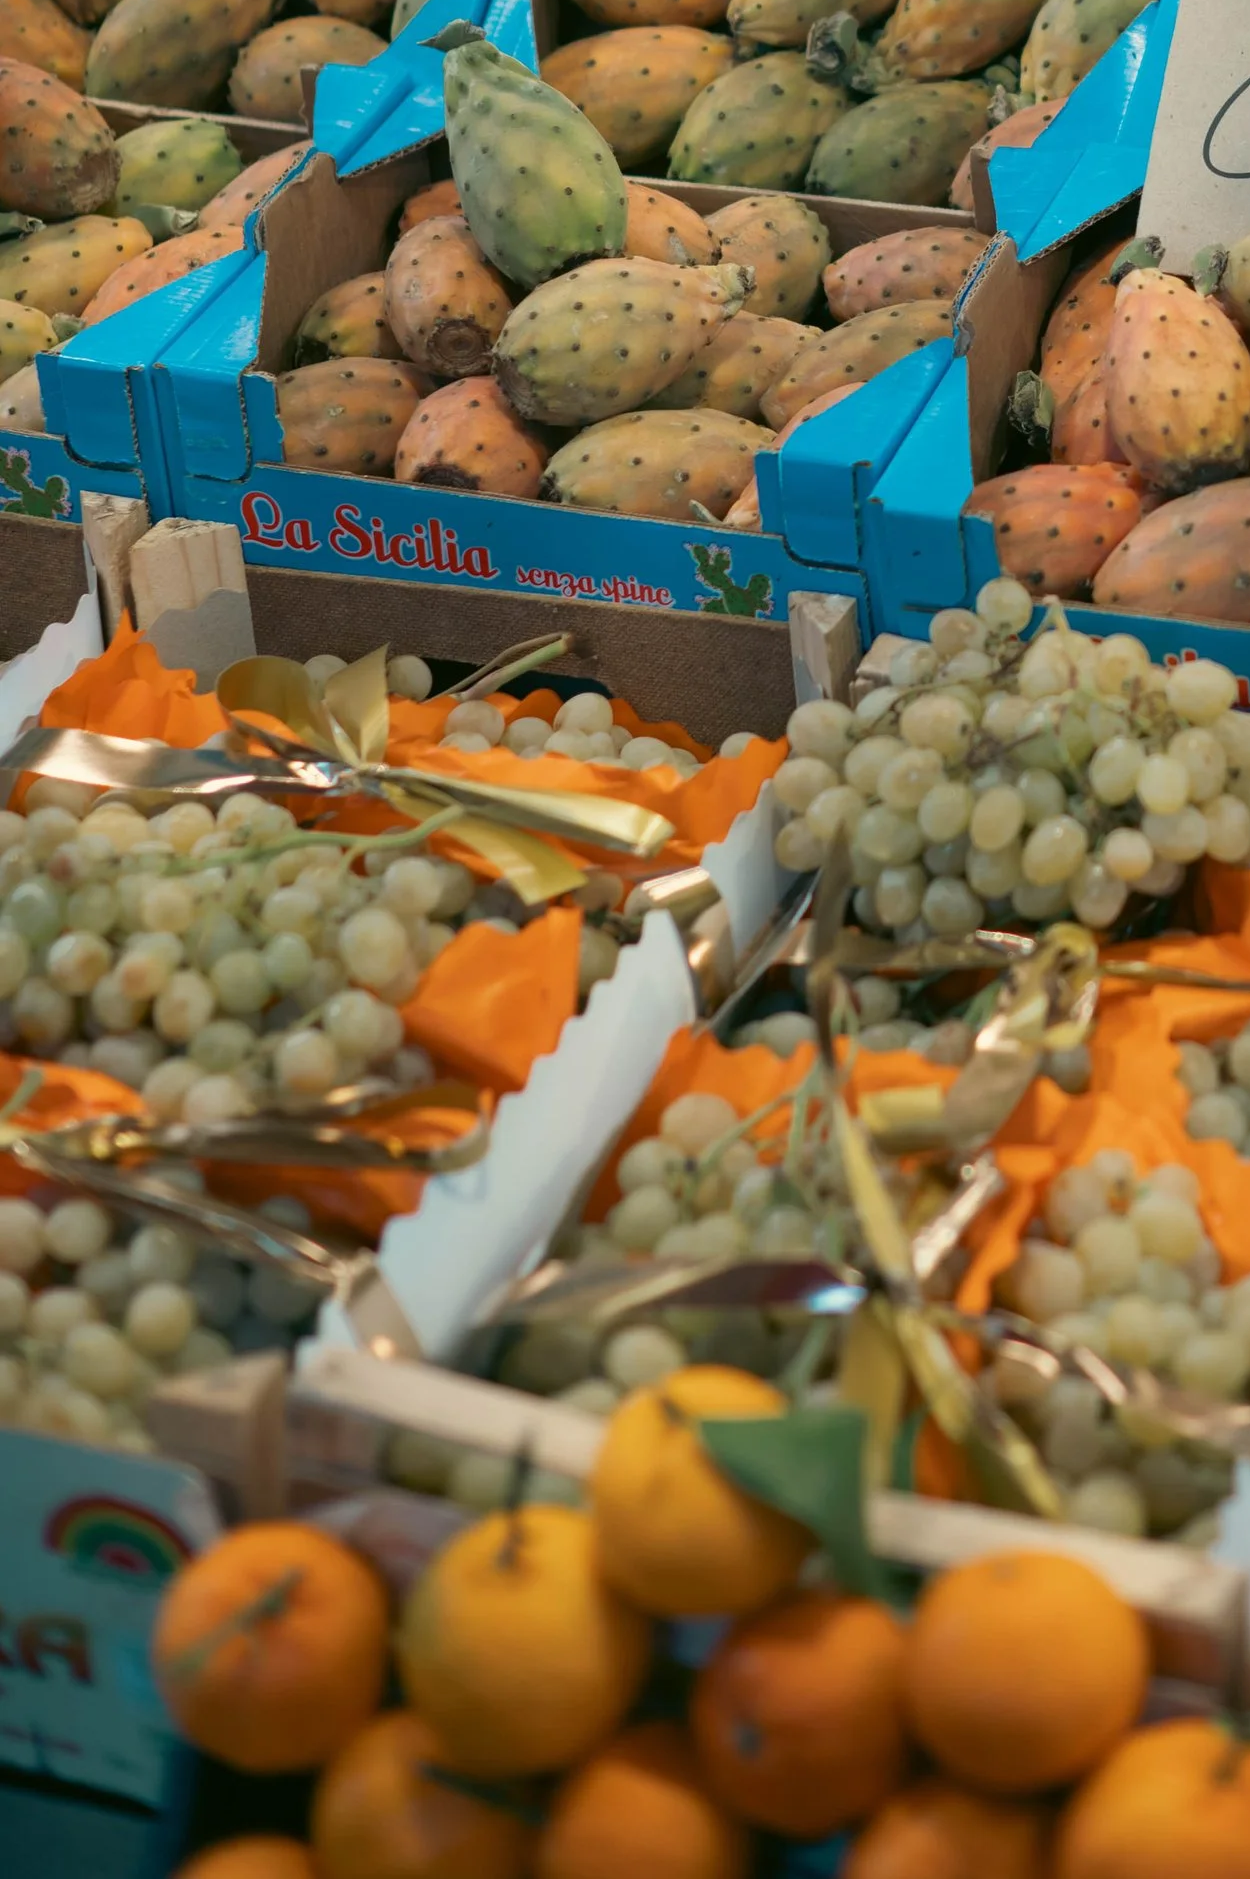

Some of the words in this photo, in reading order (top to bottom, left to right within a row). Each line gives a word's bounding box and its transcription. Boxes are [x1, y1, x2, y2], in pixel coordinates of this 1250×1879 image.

[240, 491, 322, 552] La
[329, 504, 500, 580] Sicilia
[516, 565, 597, 598] senza
[601, 574, 676, 607] spine
